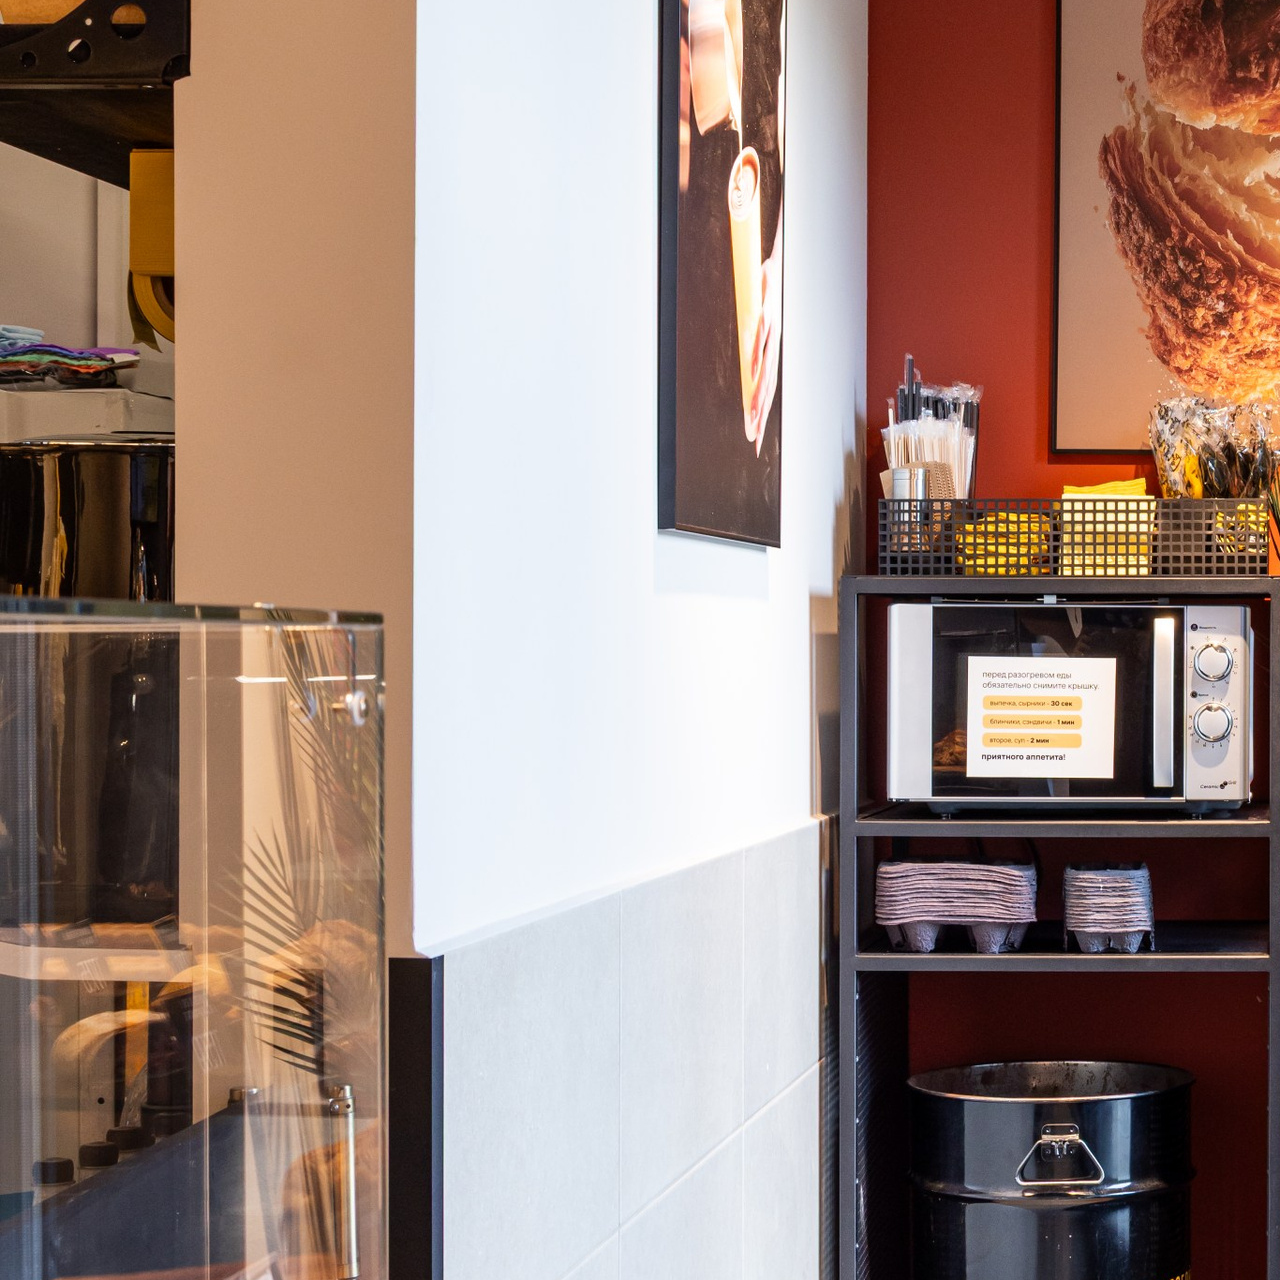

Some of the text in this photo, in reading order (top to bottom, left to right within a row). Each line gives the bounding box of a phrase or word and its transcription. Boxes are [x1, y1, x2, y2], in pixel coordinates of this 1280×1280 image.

[982, 671, 1007, 680] перед
[1007, 672, 1055, 680] разогревом
[982, 681, 1100, 691] обязательно снимите крышку.
[981, 753, 1066, 762] приятного аппетита!
